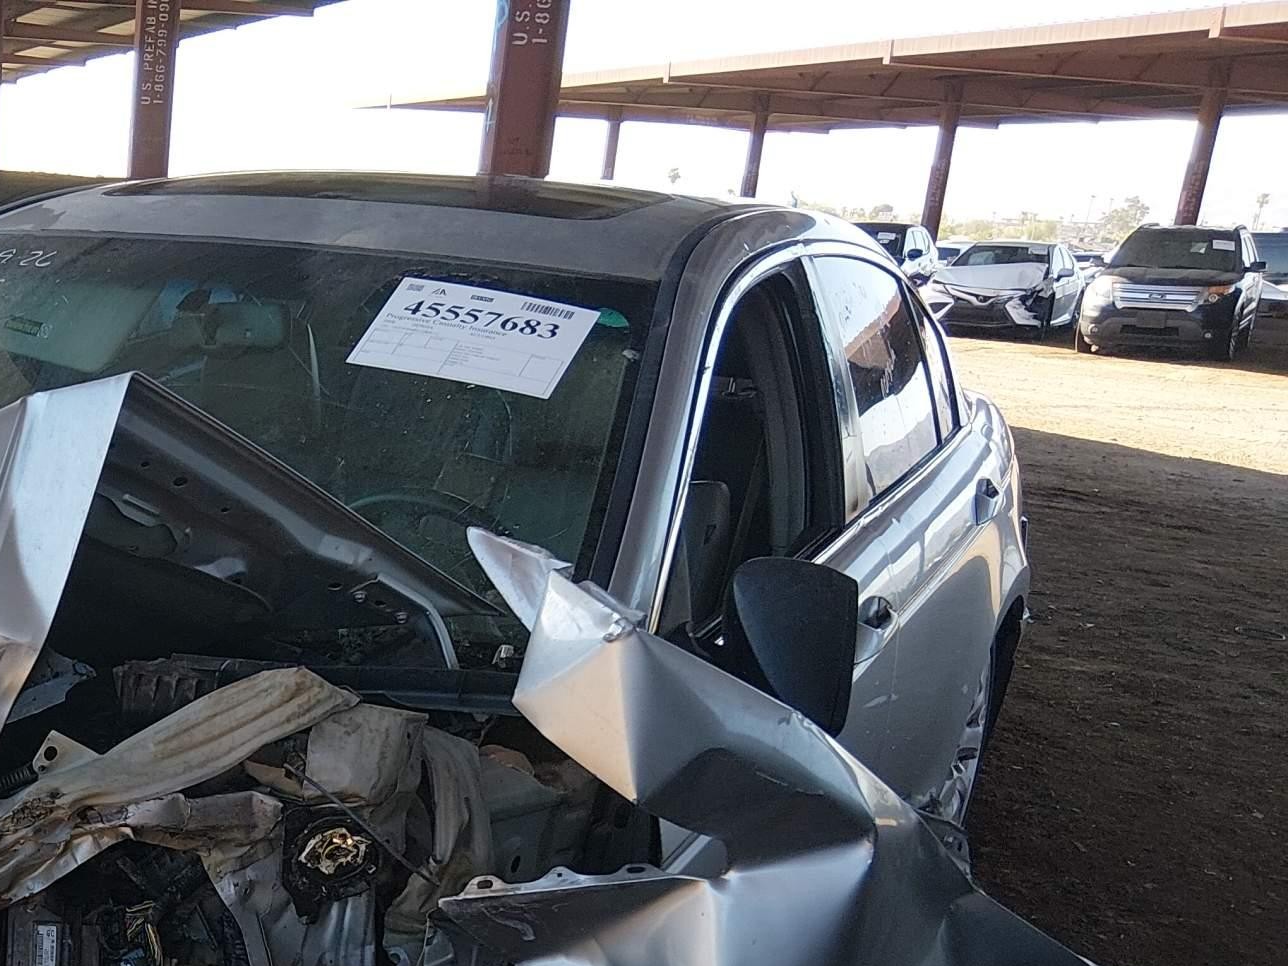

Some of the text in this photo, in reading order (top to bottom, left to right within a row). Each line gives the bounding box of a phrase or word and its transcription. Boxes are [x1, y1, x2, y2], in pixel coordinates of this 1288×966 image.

[144, 16, 156, 71] PREFAB
[153, 0, 170, 104] 1-866-799-09
[386, 312, 431, 326] Progressive
[403, 299, 561, 340] 45557683
